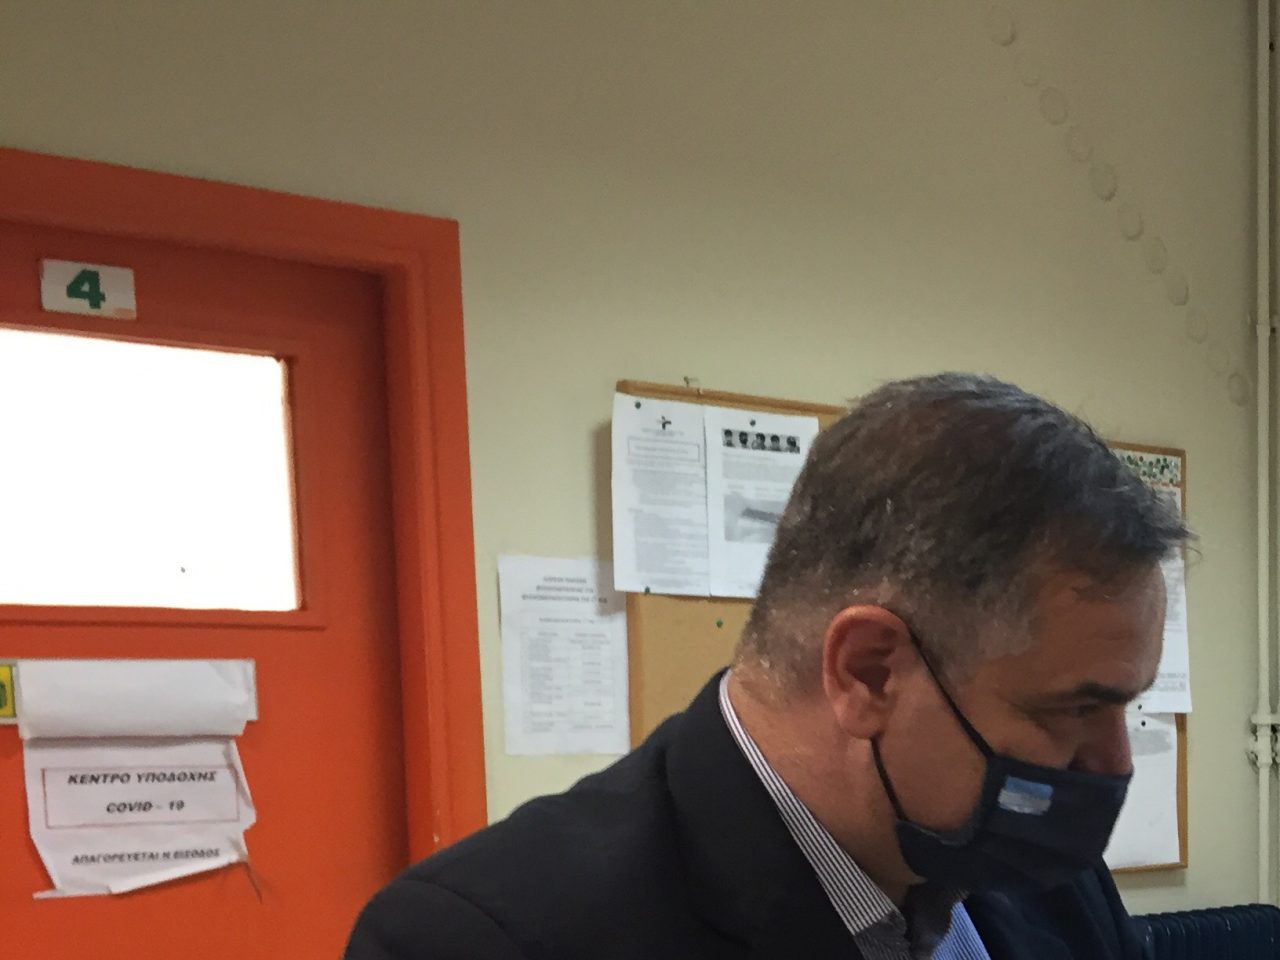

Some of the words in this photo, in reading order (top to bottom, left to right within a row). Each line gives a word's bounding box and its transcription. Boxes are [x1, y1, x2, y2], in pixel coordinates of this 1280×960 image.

[66, 268, 106, 310] 4
[67, 772, 132, 785] ΚΕΝΤΡΟ
[136, 770, 218, 785] ΥΠΟΔΟΧΗΣ
[106, 802, 153, 813] COVID
[169, 800, 185, 812] 19
